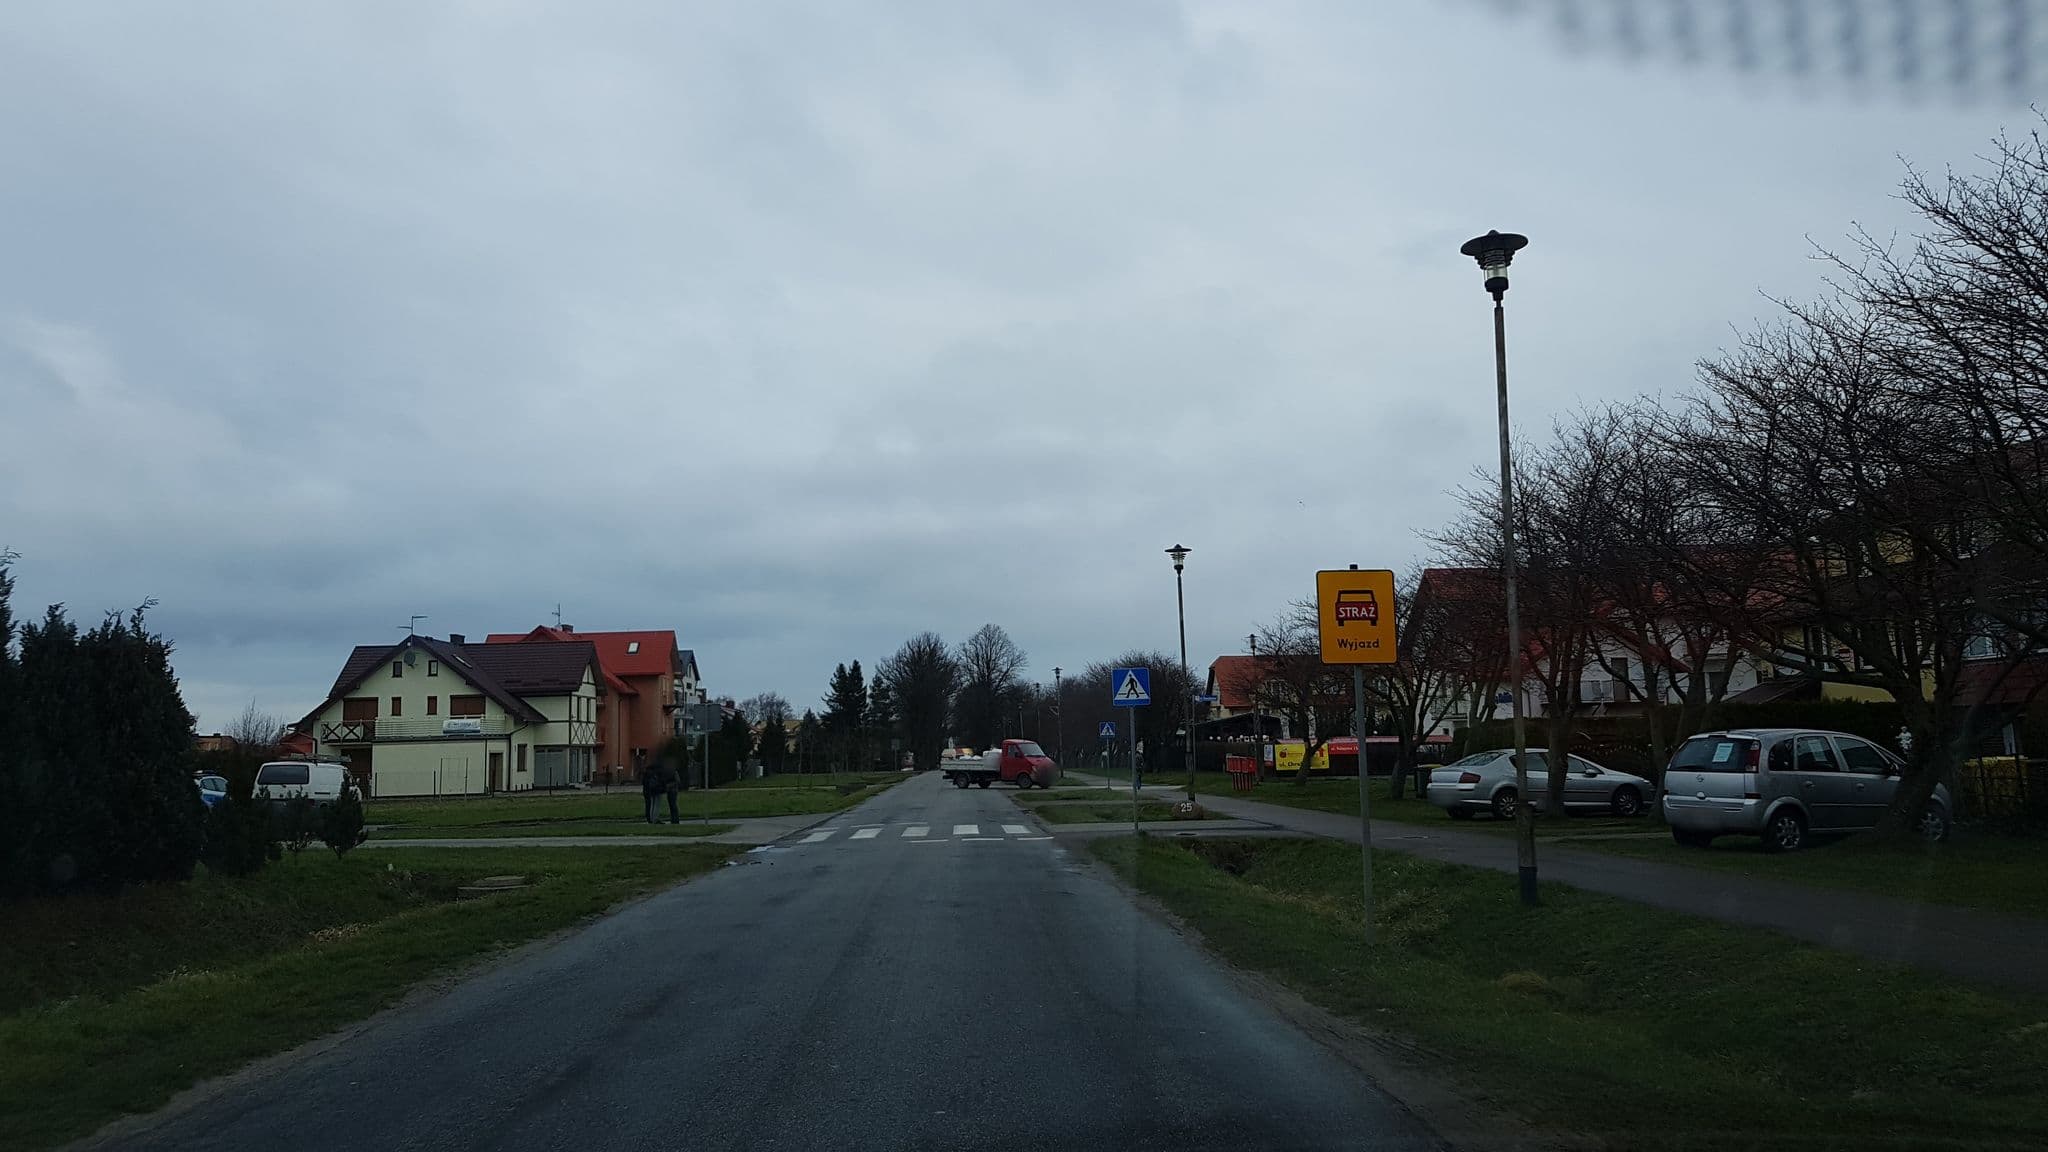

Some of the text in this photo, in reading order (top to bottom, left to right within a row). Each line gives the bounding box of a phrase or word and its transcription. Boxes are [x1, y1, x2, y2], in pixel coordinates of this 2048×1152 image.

[1338, 604, 1376, 618] STRAŻ
[1337, 638, 1380, 650] Wyjazd
[1180, 802, 1193, 813] 25
